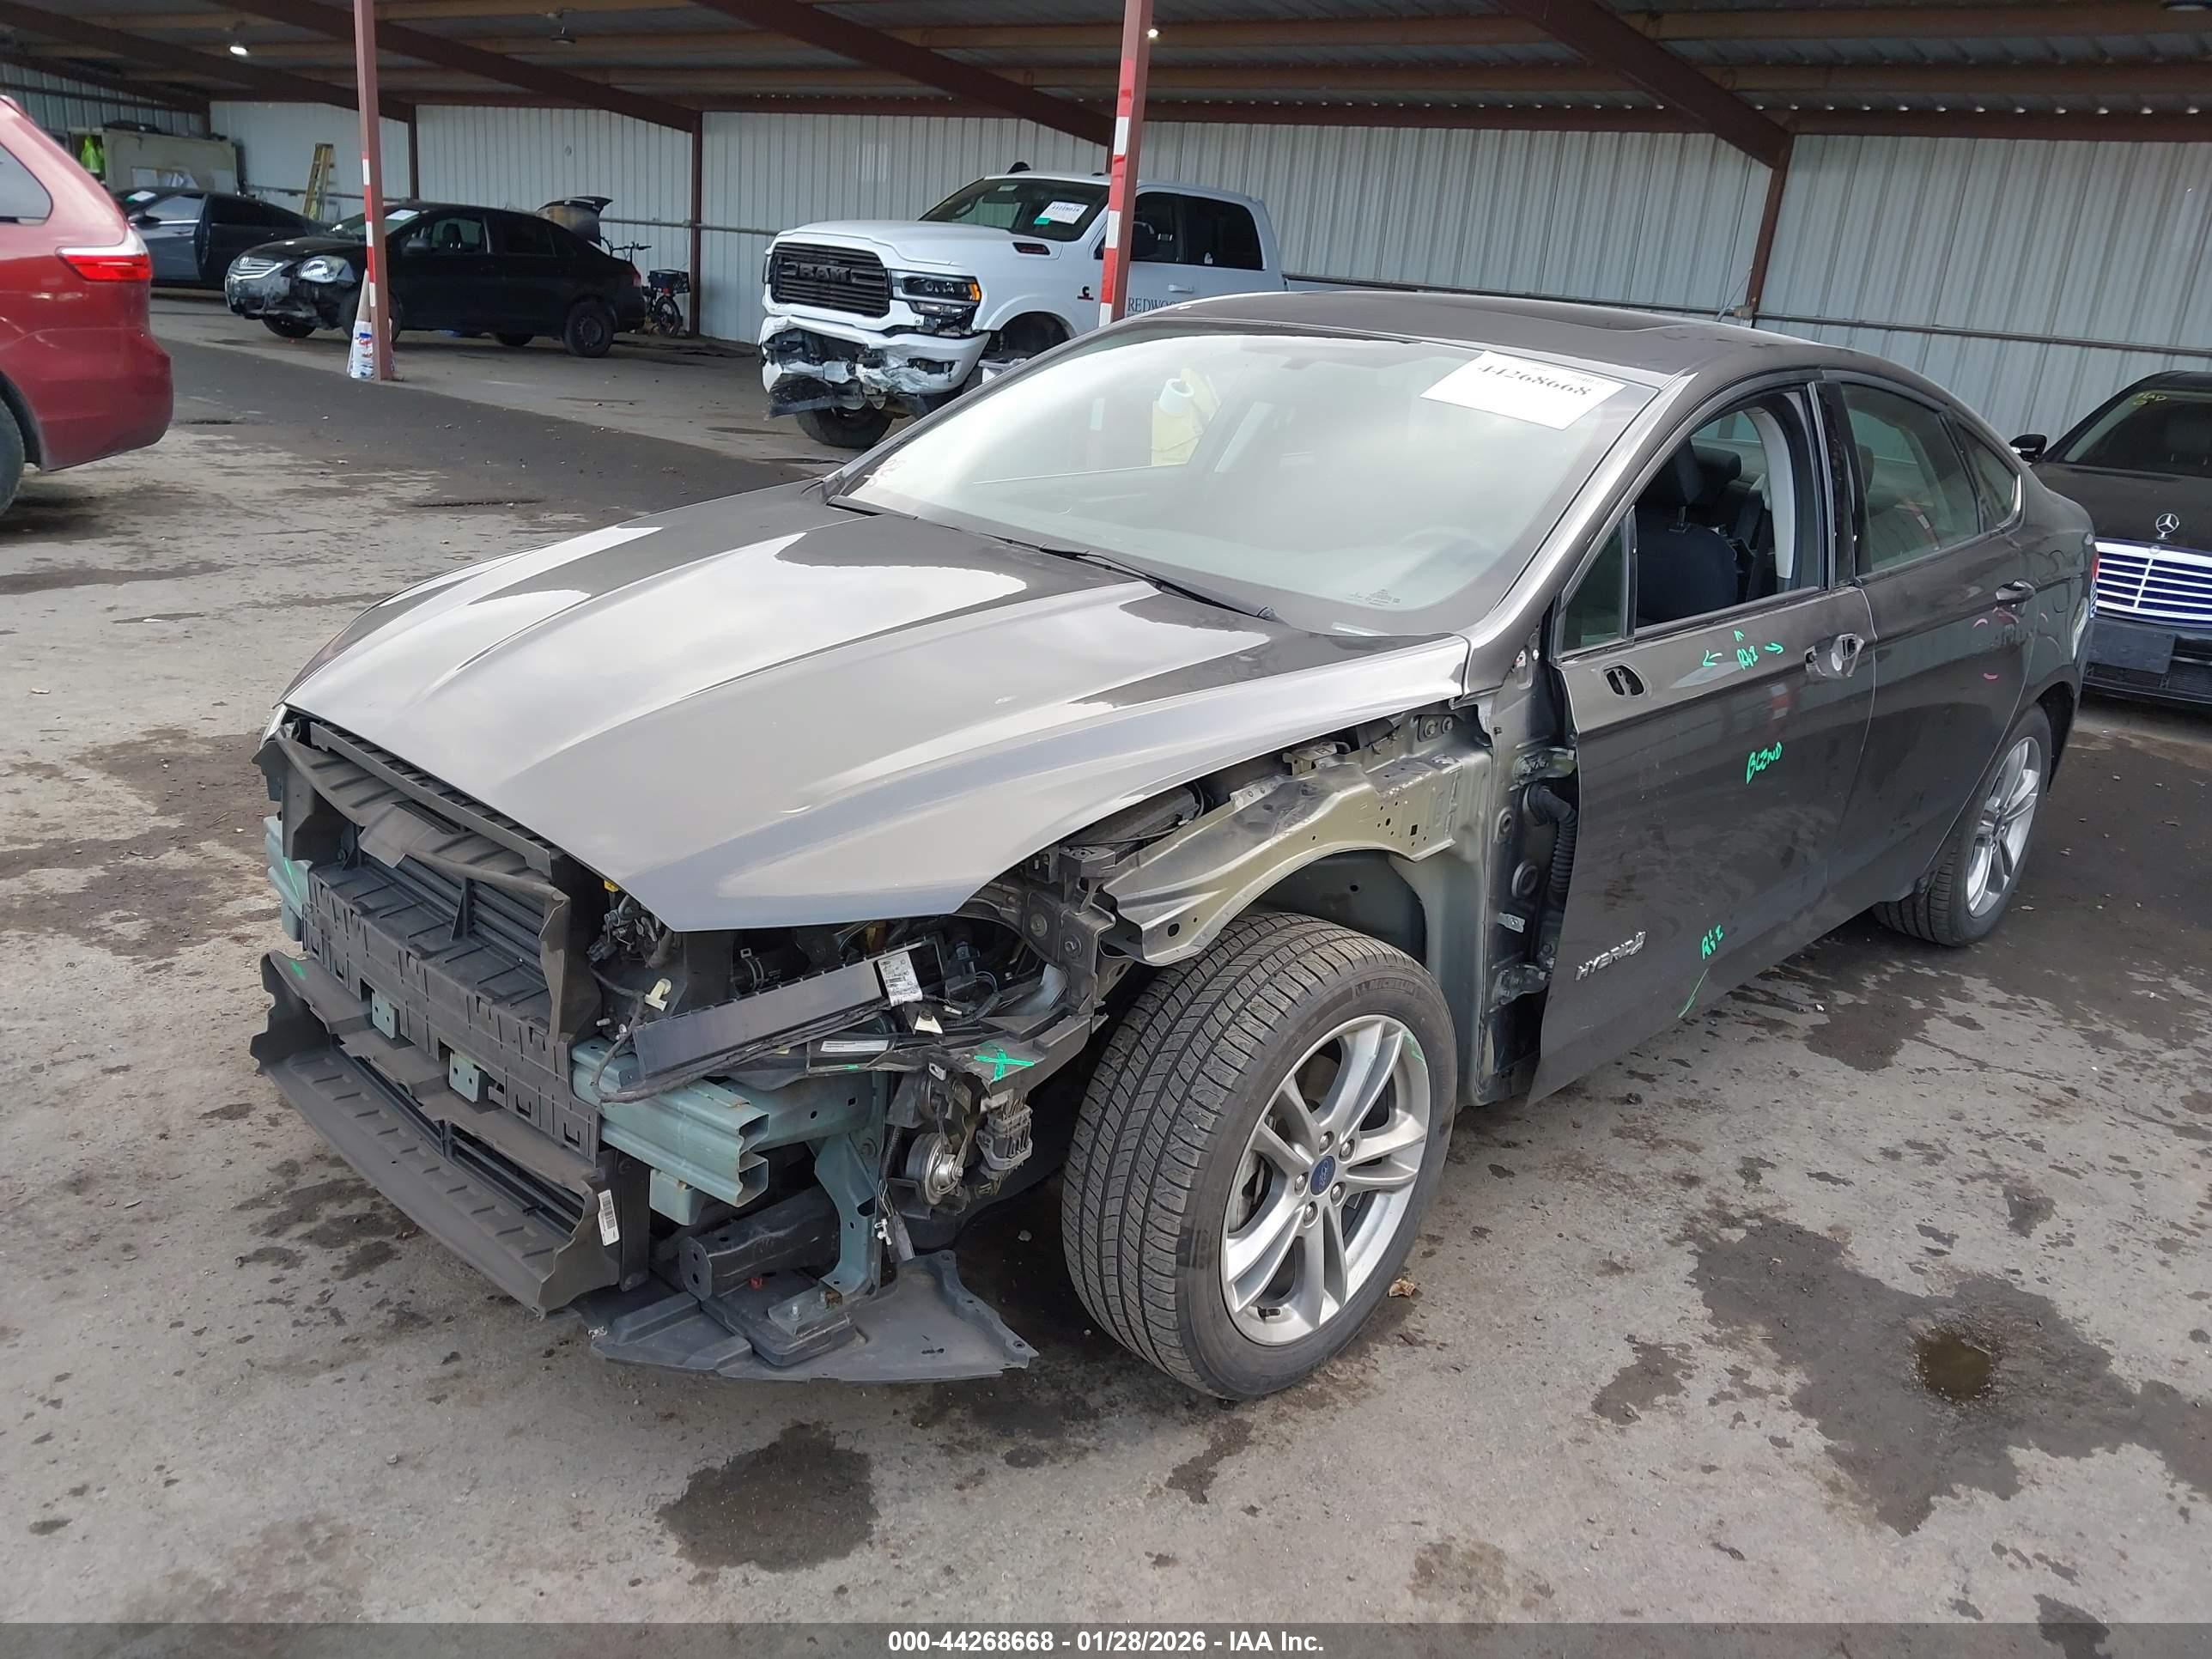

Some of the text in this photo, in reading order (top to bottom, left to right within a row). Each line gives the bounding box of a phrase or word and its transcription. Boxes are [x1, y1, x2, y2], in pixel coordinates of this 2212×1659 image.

[799, 263, 850, 283] RAM
[1478, 365, 1592, 396] 44268668
[1575, 931, 1647, 981] HYBRID
